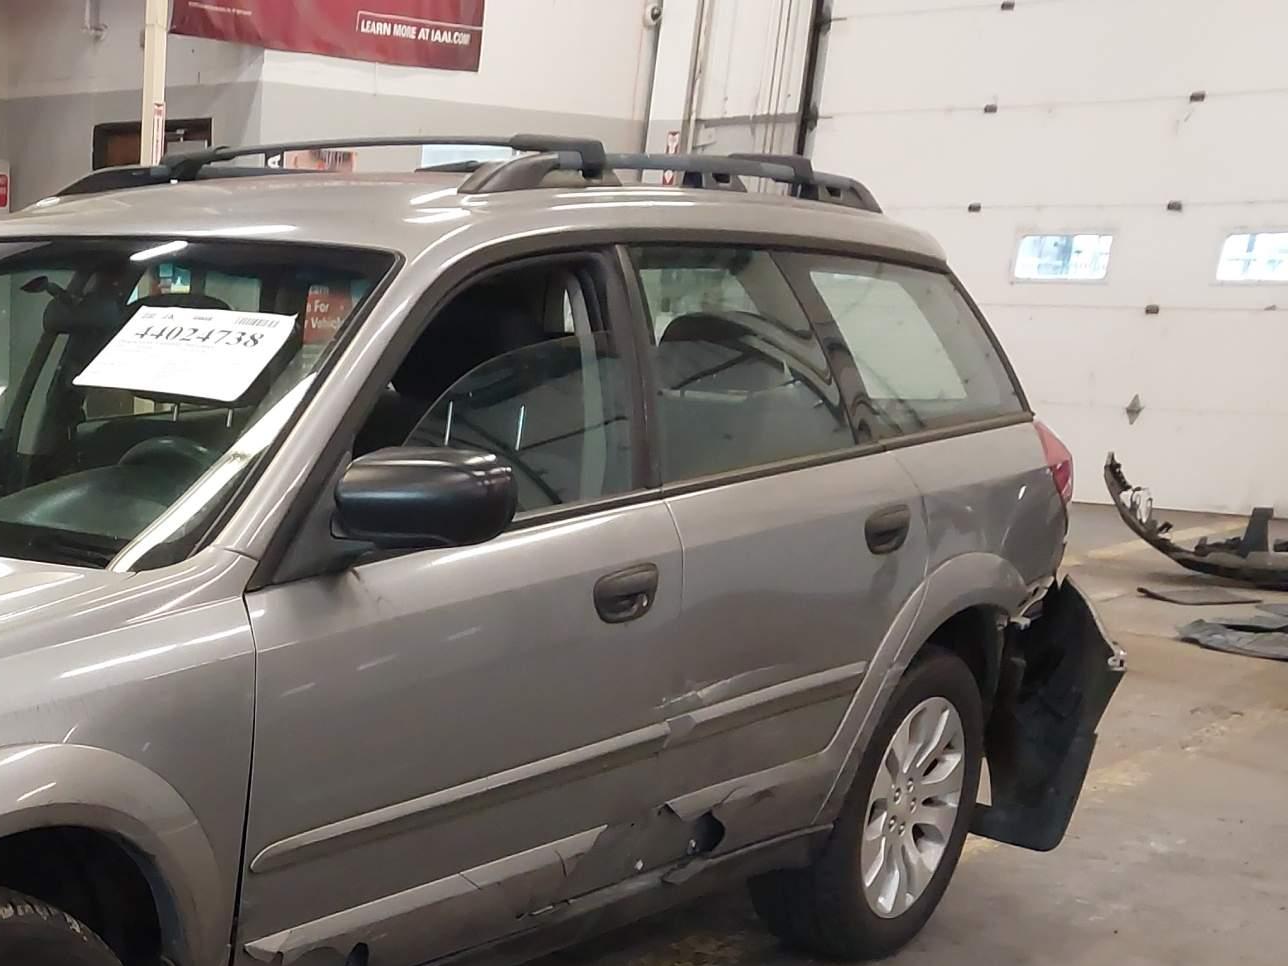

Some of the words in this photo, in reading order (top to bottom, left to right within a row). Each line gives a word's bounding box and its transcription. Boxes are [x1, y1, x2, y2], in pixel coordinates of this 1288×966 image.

[360, 18, 391, 37] LEARN
[392, 23, 417, 40] MORE
[418, 27, 430, 41] AT
[430, 29, 471, 46] IAAI.COM
[135, 324, 264, 348] 44024738
